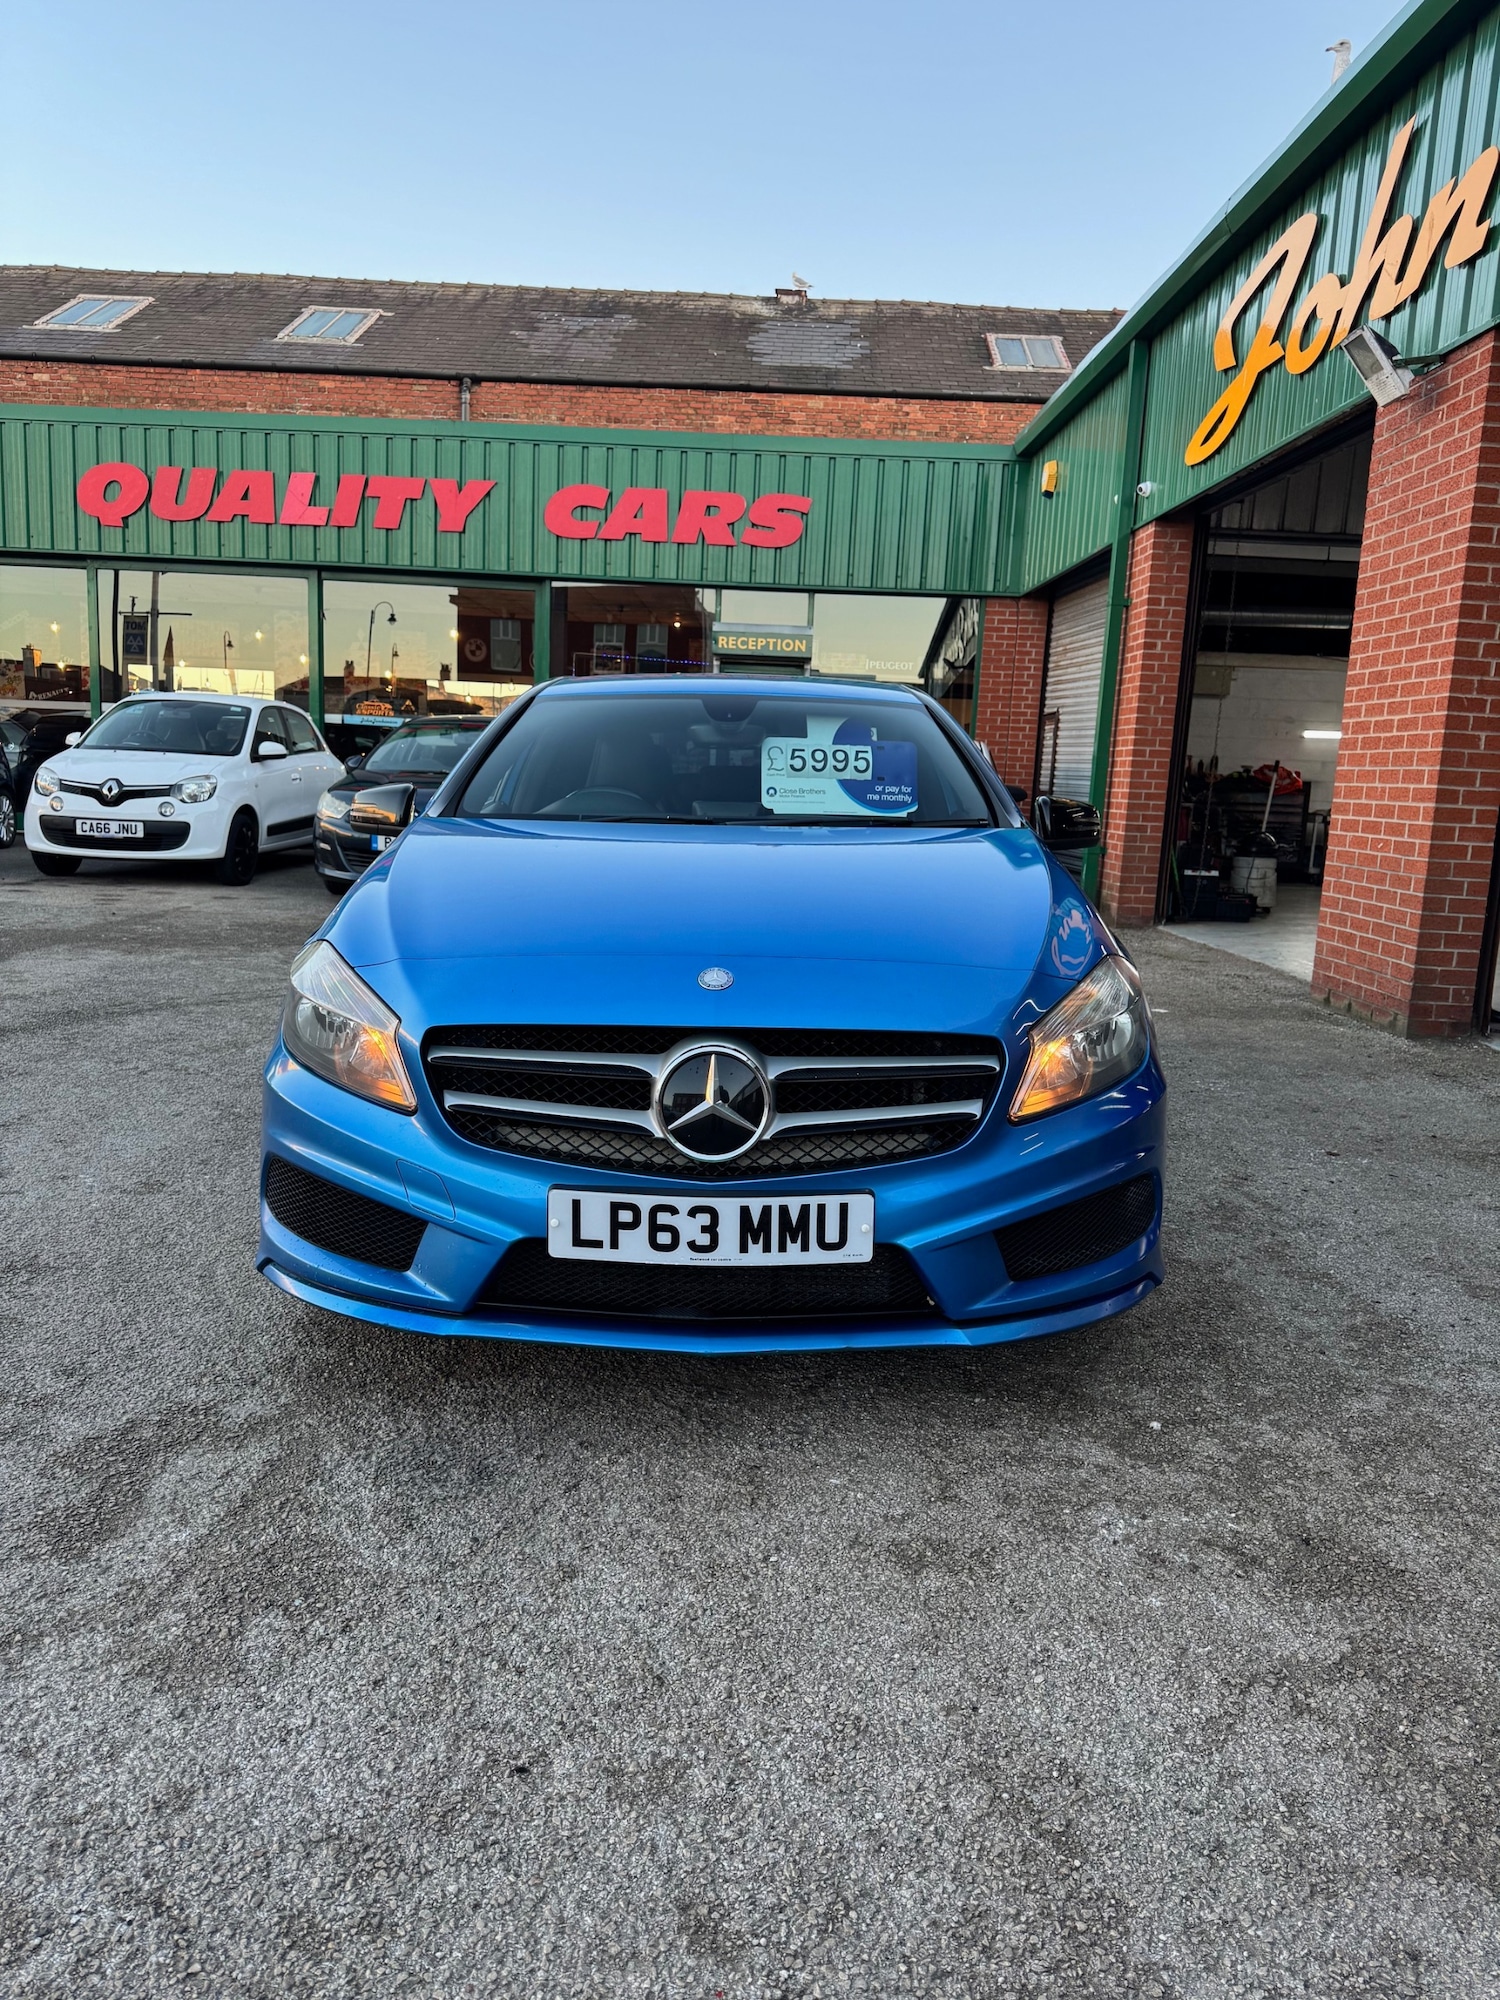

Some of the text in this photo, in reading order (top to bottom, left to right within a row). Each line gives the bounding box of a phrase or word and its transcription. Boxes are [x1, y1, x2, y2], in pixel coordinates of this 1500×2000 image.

[1185, 114, 1499, 466] John
[76, 462, 812, 548] QUALITY CARS
[717, 636, 807, 653] RECEPTION
[869, 660, 914, 671] PEUGEOT
[766, 745, 870, 773] £5995
[778, 787, 826, 796] Close Brothers
[885, 786, 900, 794] pay
[901, 785, 913, 793] for
[866, 793, 913, 804] me monthly
[80, 821, 138, 835] CA66 JNU
[571, 1198, 849, 1254] LP63 MMU
